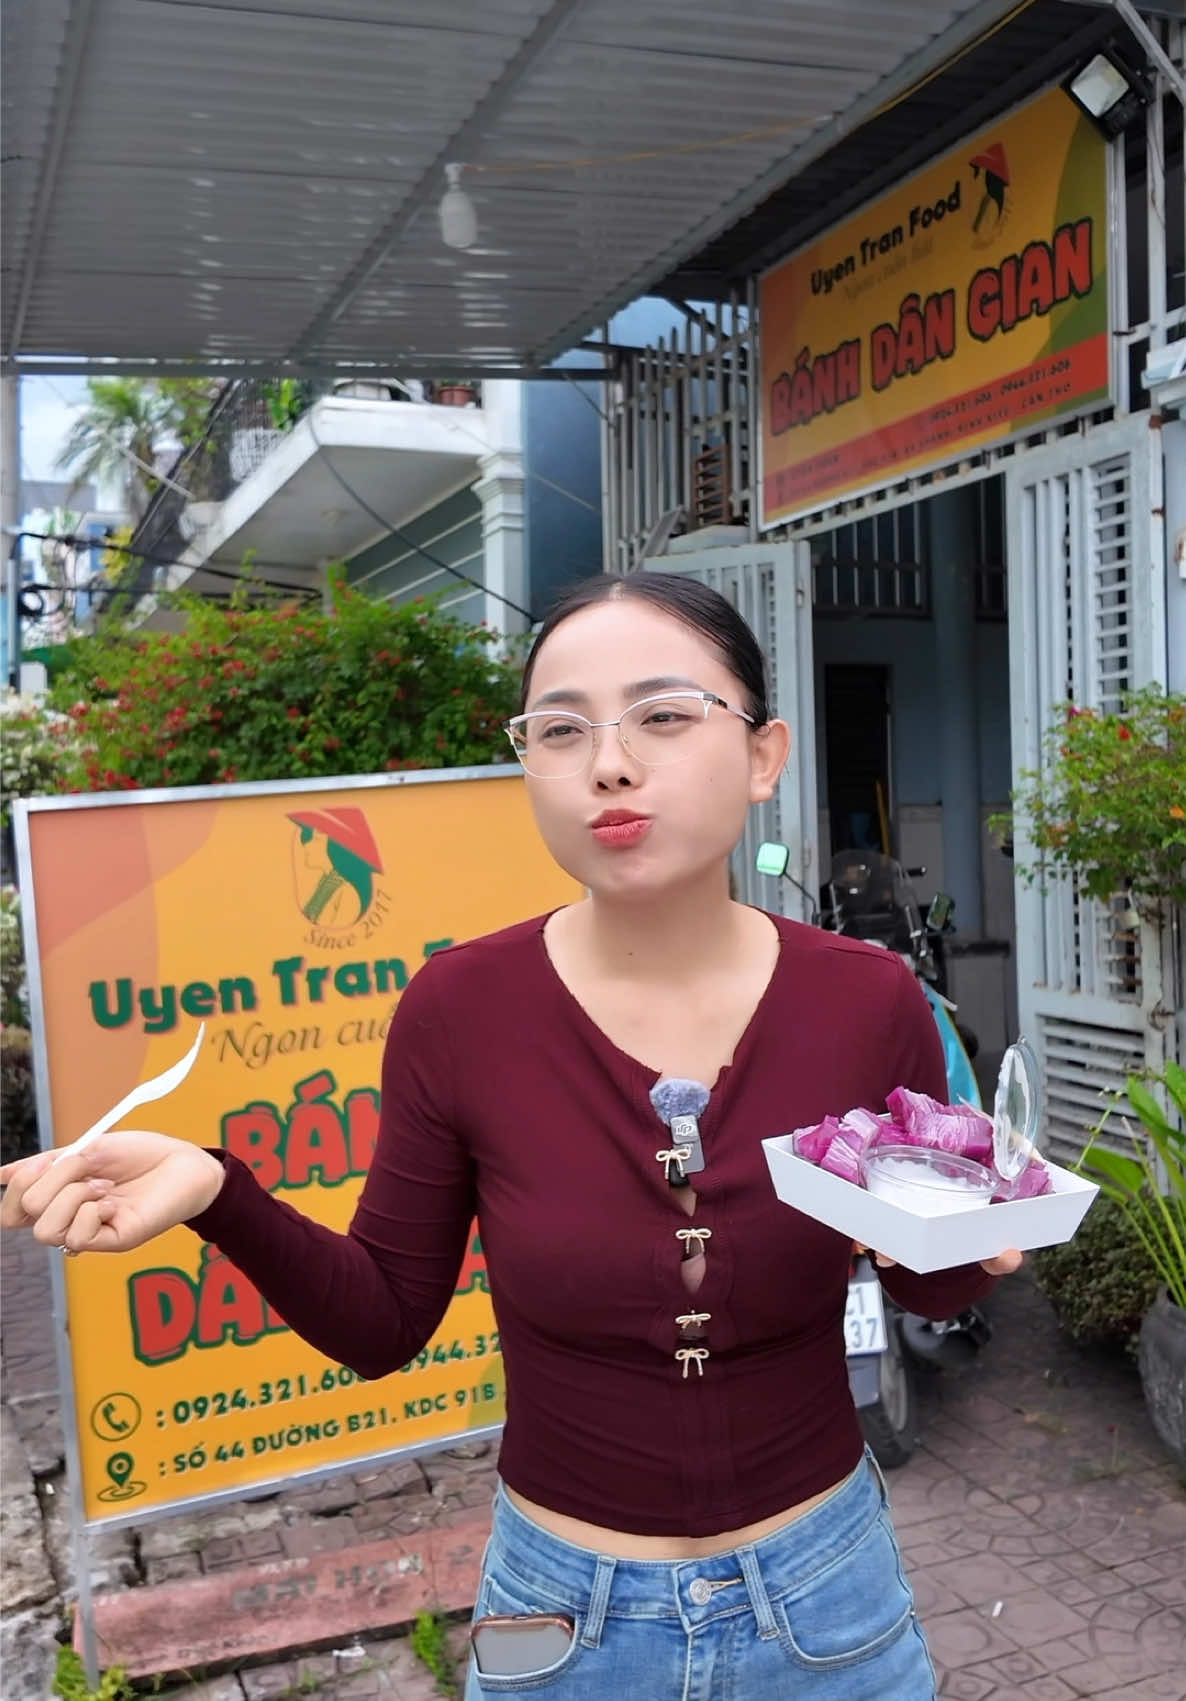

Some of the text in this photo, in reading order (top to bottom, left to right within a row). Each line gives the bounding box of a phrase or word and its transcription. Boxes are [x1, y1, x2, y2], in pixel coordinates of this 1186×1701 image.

[811, 269, 855, 295] Uyen
[860, 225, 903, 267] Tran
[909, 180, 961, 237] Food
[770, 337, 861, 436] BÁNH
[870, 289, 955, 393] DÂN
[967, 217, 1093, 342] GIAN
[304, 888, 393, 950] Since 2017
[89, 955, 410, 1035] Uyen Tran
[211, 1021, 321, 1070] Ngon
[127, 1241, 292, 1368] DÂ
[214, 1440, 245, 1462] 44
[404, 1393, 448, 1419] KDC
[455, 1383, 497, 1406] 91B
